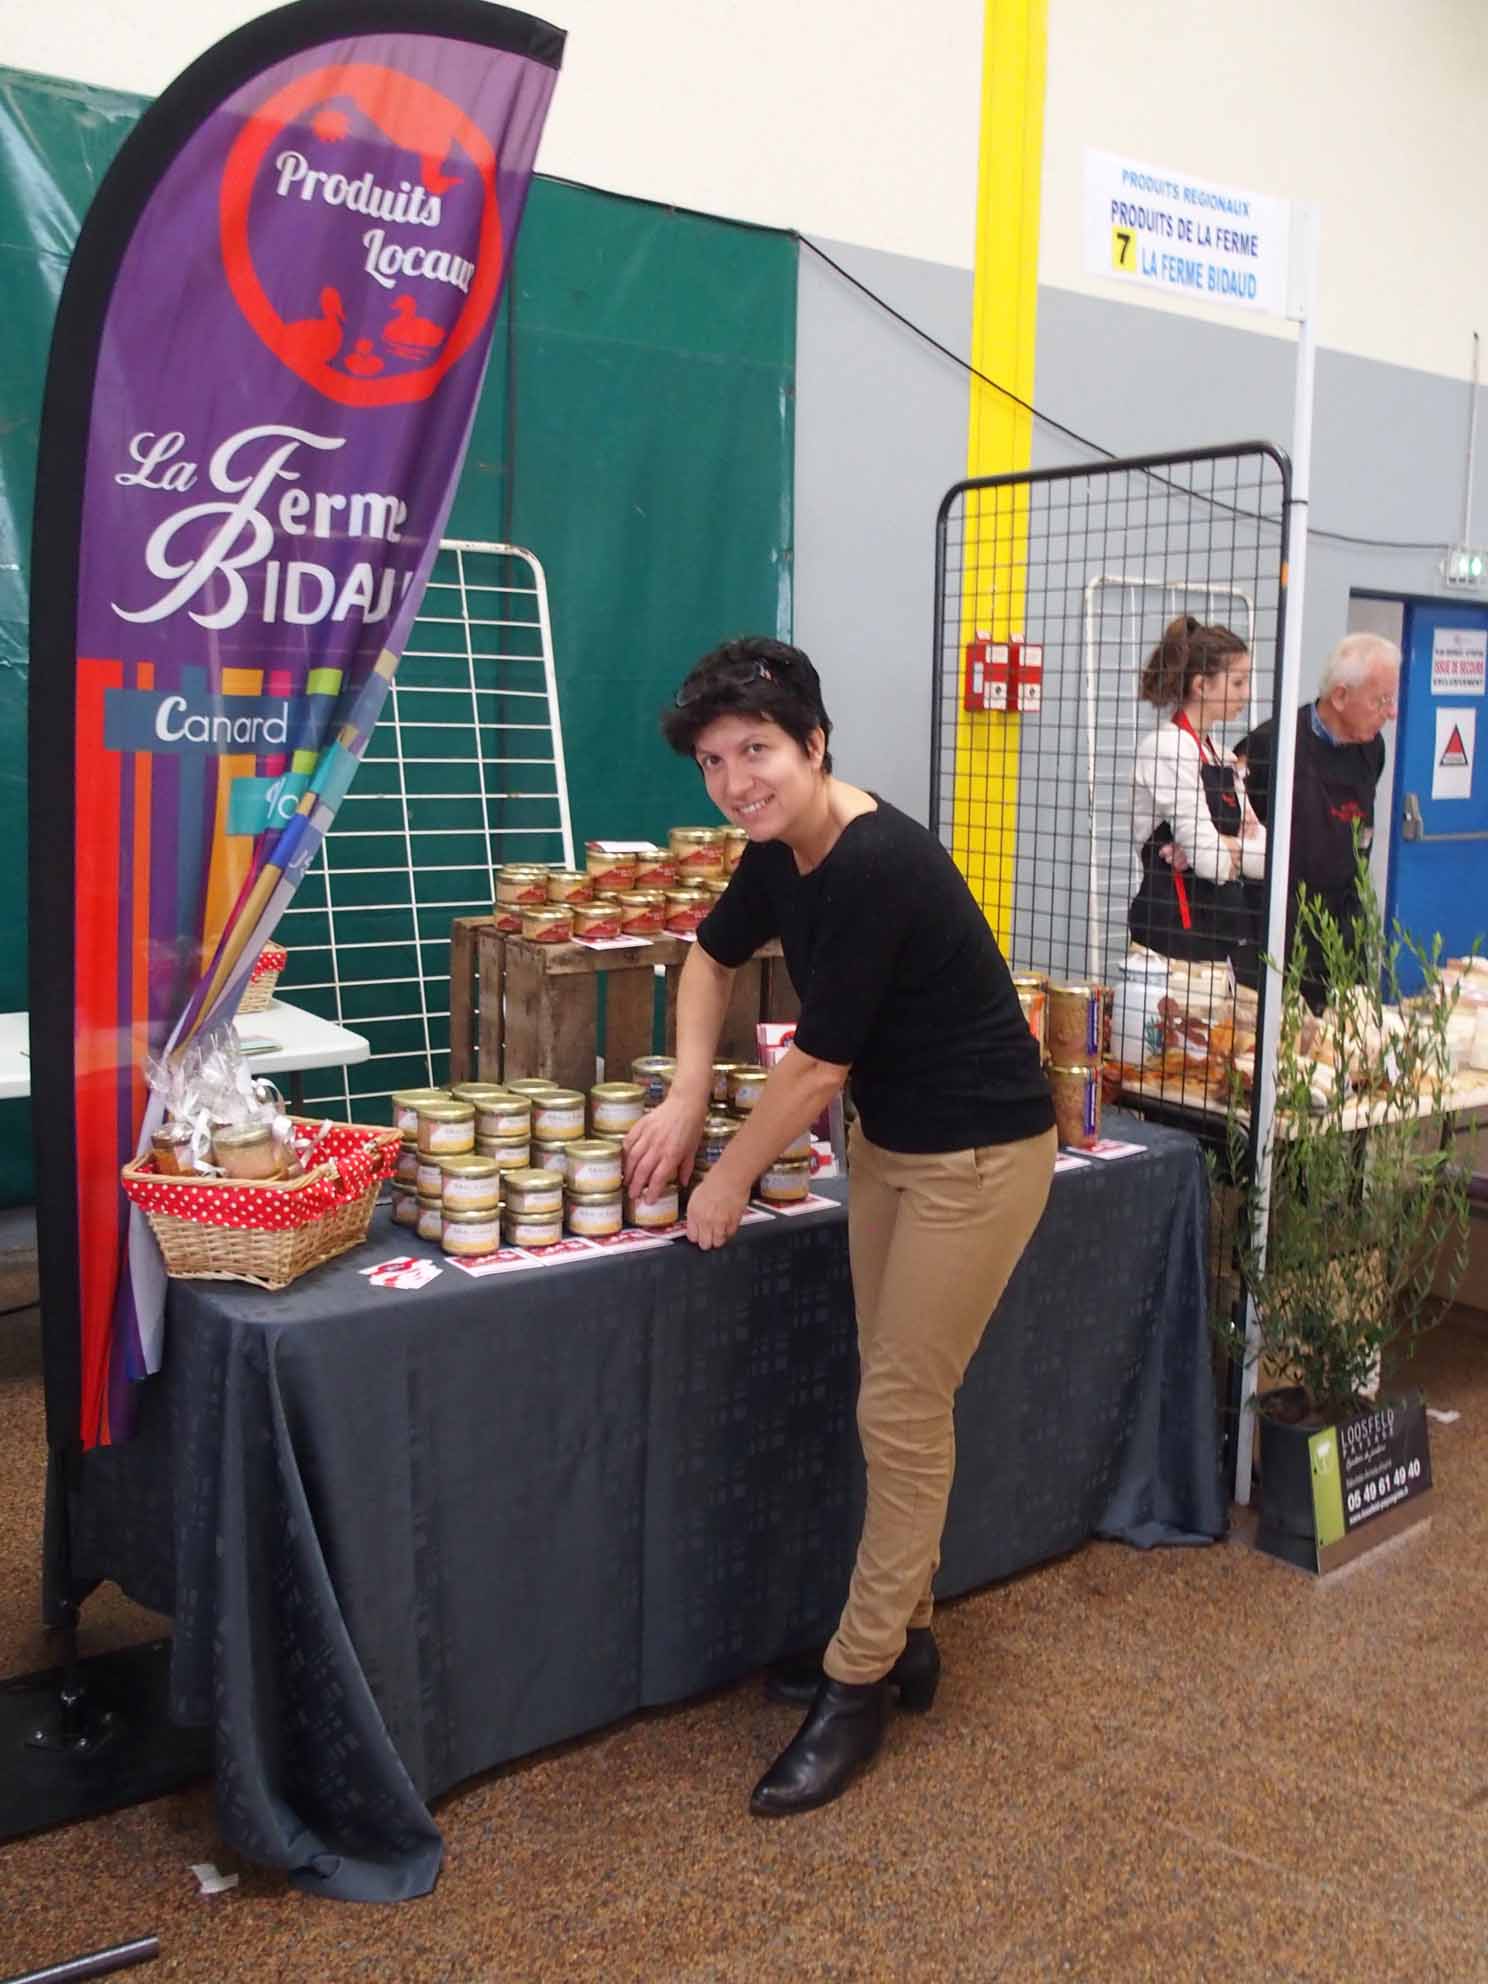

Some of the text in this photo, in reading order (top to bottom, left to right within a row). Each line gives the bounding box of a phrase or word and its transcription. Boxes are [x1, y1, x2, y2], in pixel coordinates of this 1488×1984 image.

[276, 150, 441, 227] Produits
[1121, 168, 1180, 201] PRODUITS
[1111, 200, 1259, 258] PRODUITS DE LA FERME
[1116, 232, 1131, 265] 7
[362, 228, 475, 296] Locau
[1141, 247, 1257, 300] LA FERME BIDAUD
[114, 424, 408, 542] La Ferme
[155, 695, 288, 744] Canard
[1348, 1490, 1361, 1512] 05
[1378, 1473, 1391, 1496] 61
[1408, 1458, 1421, 1479] 40
